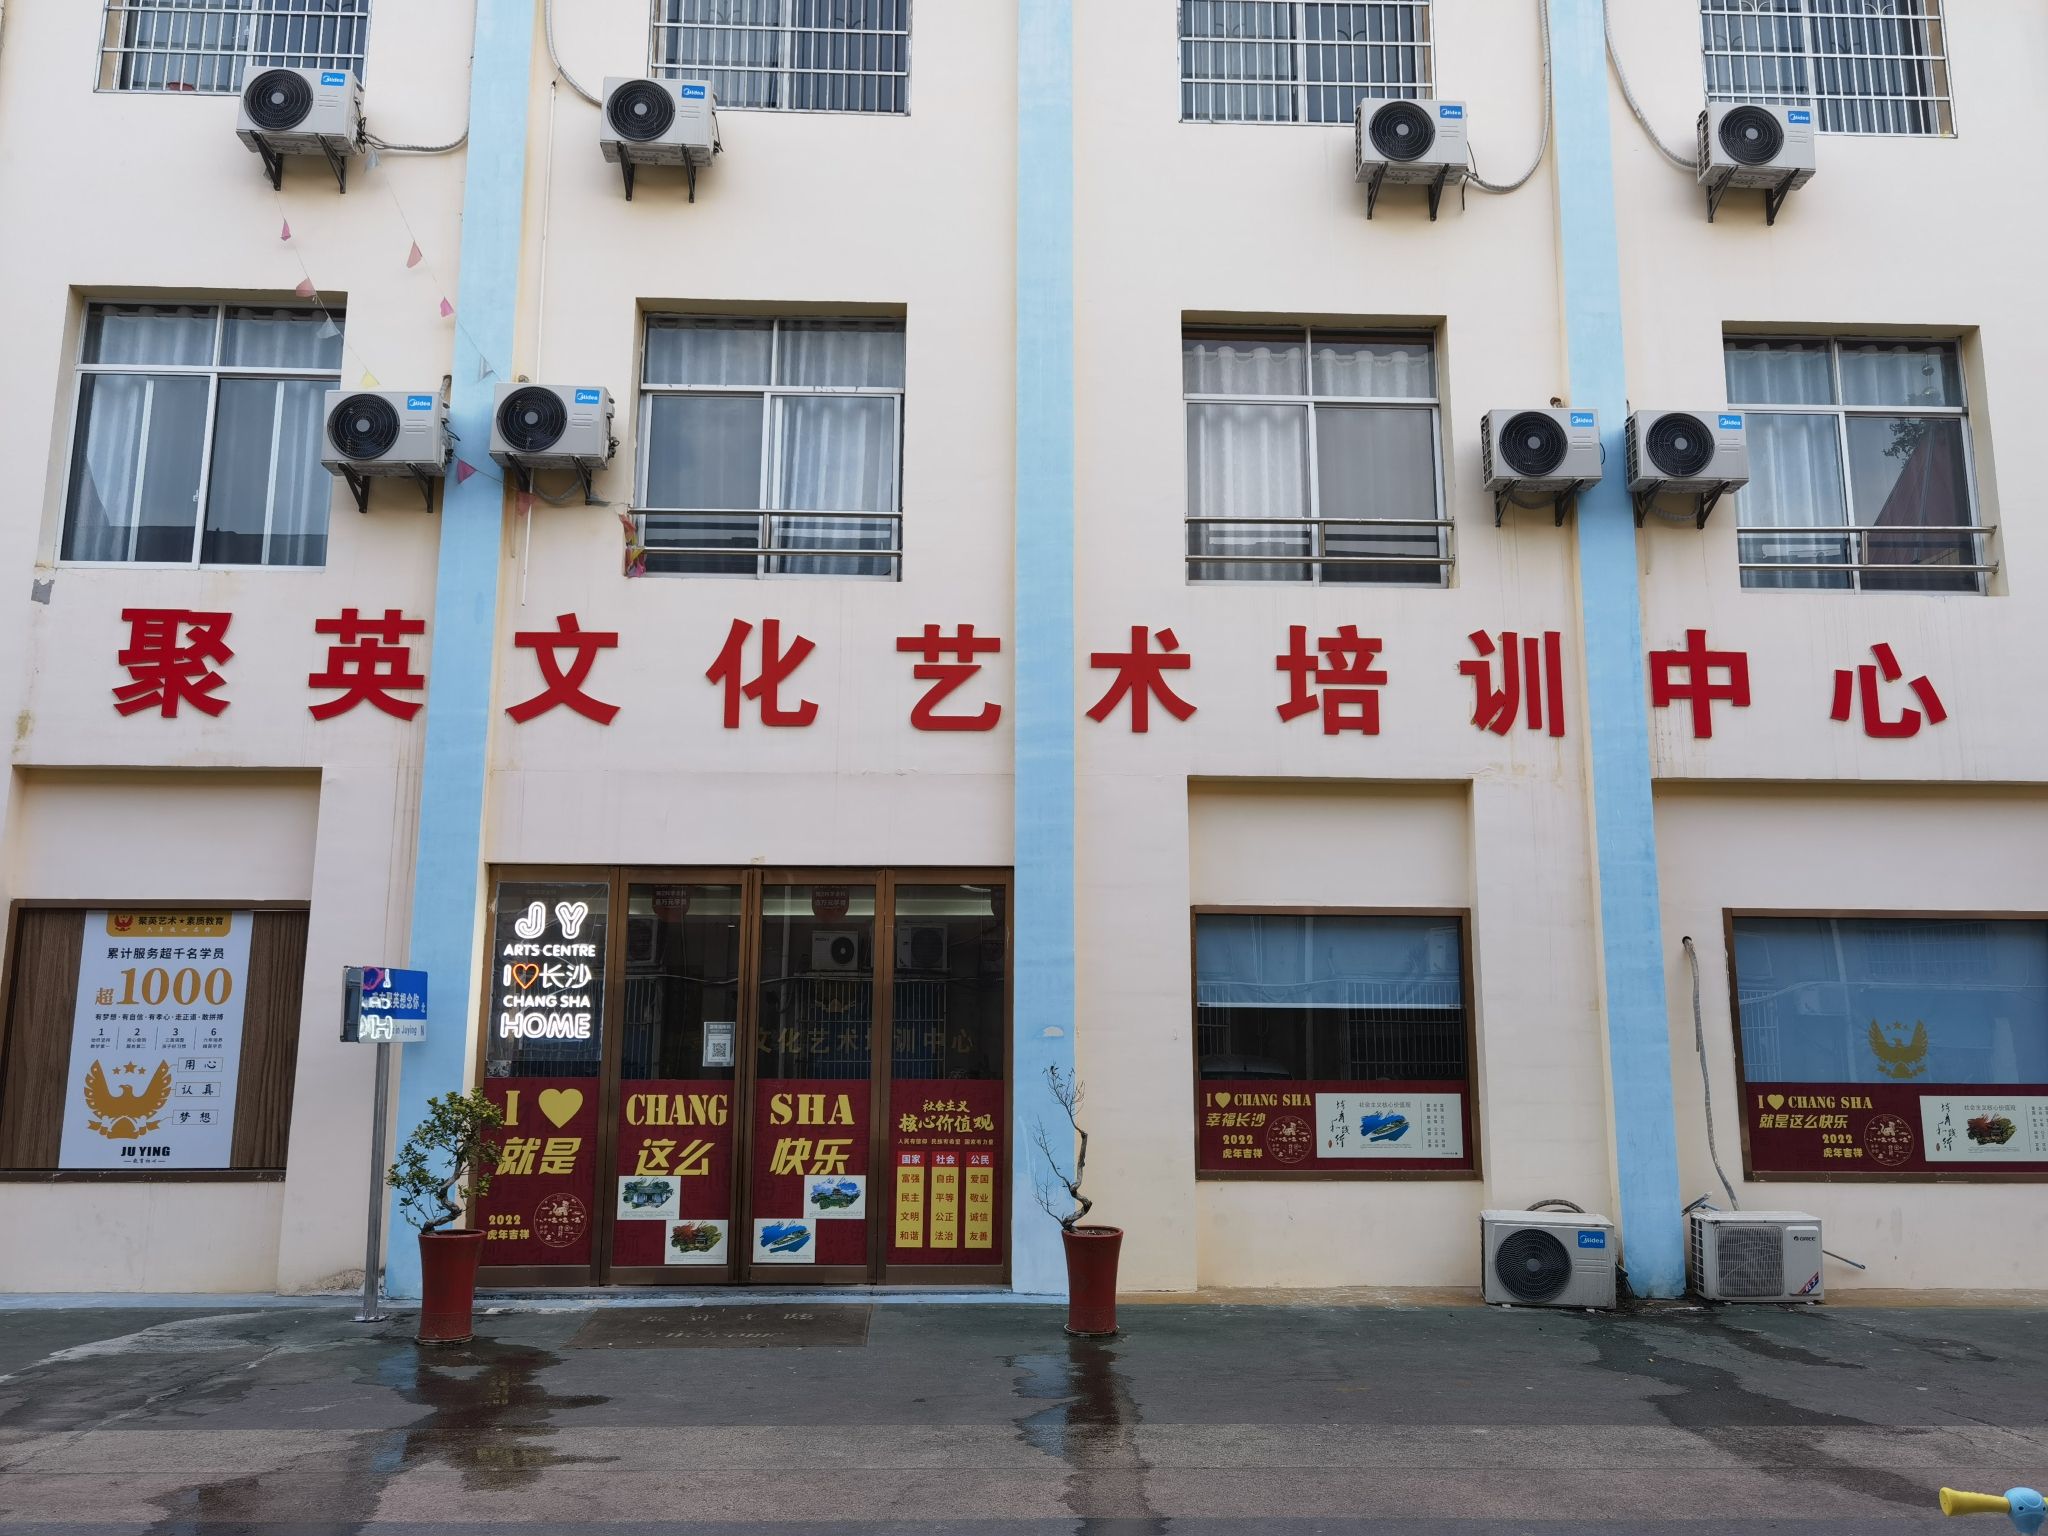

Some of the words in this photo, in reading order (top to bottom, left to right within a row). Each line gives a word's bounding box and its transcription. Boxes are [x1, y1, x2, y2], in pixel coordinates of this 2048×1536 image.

[576, 391, 599, 401] Midea
[408, 398, 431, 407] Midea
[1571, 415, 1593, 424] Midea
[1718, 417, 1742, 427] Midea
[112, 608, 1947, 738] 聚英文化艺术培训中心
[106, 947, 225, 960] 累计服务超千名学员
[503, 944, 540, 957] ARTS
[542, 944, 596, 957] CENTRE
[539, 962, 592, 989] 长沙
[116, 966, 233, 1006] 1000
[502, 995, 557, 1008] CHANG
[560, 995, 591, 1008] SHA
[499, 1012, 591, 1039] HOME
[99, 1028, 104, 1036] 1
[134, 1028, 141, 1036] 2
[172, 1028, 179, 1036] 3
[211, 1028, 217, 1036] 6
[1206, 1093, 1212, 1107] I
[1234, 1093, 1278, 1107] CHANG
[1283, 1093, 1312, 1107] SHA
[1757, 1095, 1764, 1109] I
[1788, 1095, 1836, 1109] CHANG
[1840, 1096, 1873, 1110] SHA
[503, 1090, 520, 1126] I
[625, 1093, 728, 1127] CHANG
[770, 1093, 855, 1126] SHA
[922, 1099, 970, 1113] 社会主义
[898, 1113, 995, 1133] 核心价值观
[1205, 1112, 1266, 1128] 幸福长沙
[1759, 1114, 1849, 1130] 就是这么快乐
[1222, 1134, 1254, 1145] 2022
[1822, 1133, 1853, 1145] 2022
[121, 1146, 136, 1157] JU
[139, 1146, 171, 1157] YING
[495, 1136, 582, 1175] 就是
[634, 1138, 716, 1176] 这么
[769, 1137, 853, 1175] 快乐
[1222, 1148, 1263, 1159] 虎年吉祥
[1823, 1147, 1864, 1159] 虎年吉祥
[902, 1154, 921, 1164] 国家
[935, 1154, 955, 1164] 社会
[970, 1154, 990, 1165] 公民
[902, 1174, 920, 1184] 富强
[936, 1174, 955, 1184] 自由
[970, 1174, 989, 1184] 爱国
[901, 1193, 920, 1203] 民主
[935, 1193, 954, 1203] 平等
[970, 1193, 989, 1203] 敬业
[488, 1214, 521, 1226] 2022
[900, 1212, 919, 1222] 文明
[935, 1212, 954, 1222] 公正
[970, 1212, 988, 1222] 诚信
[486, 1229, 530, 1240] 虎年吉祥
[900, 1231, 918, 1241] 和谐
[934, 1231, 954, 1241] 法治
[970, 1231, 988, 1241] 友善
[1580, 1234, 1604, 1246] Midea
